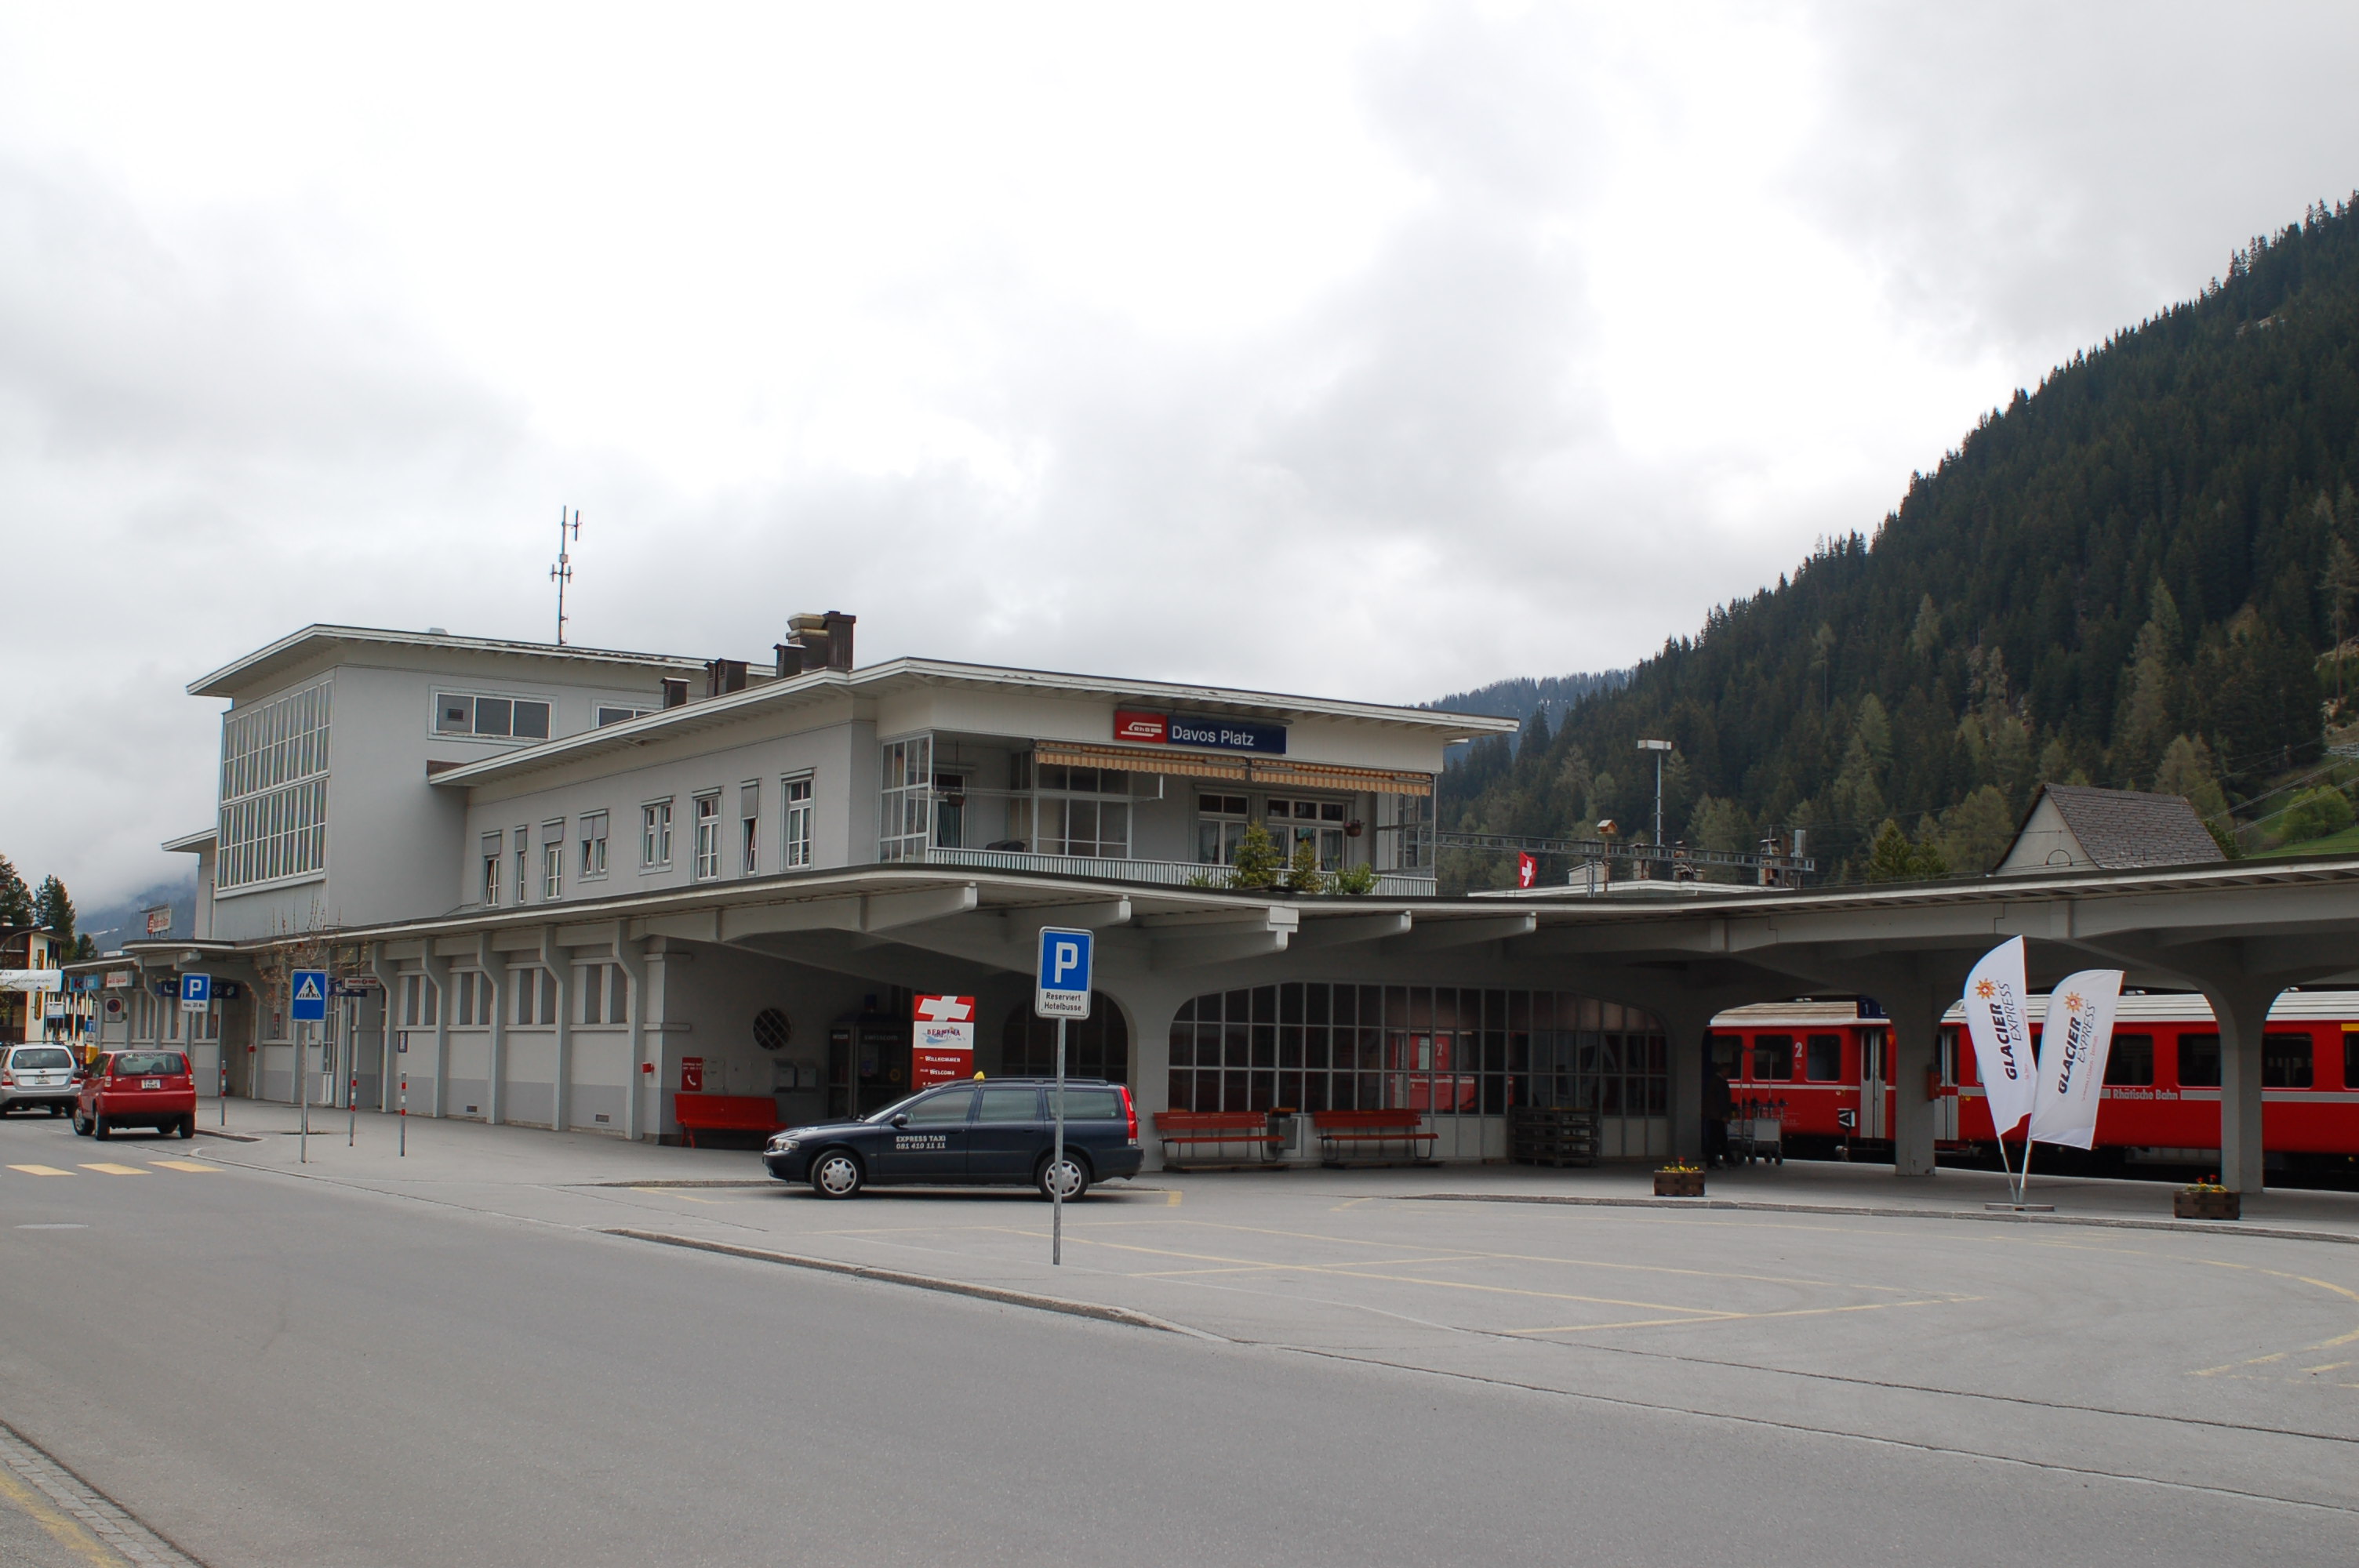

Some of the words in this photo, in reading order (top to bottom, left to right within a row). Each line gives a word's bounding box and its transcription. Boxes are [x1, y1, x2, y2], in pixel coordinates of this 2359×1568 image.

[1172, 725, 1216, 743] Davos
[1220, 730, 1254, 746] Platz
[1054, 942, 1078, 983] P
[189, 979, 202, 997] P
[1045, 992, 1081, 1002] Reserviert
[1044, 1001, 1082, 1011] Hotelbusse
[1999, 983, 2023, 1042] EXPRESS
[1989, 1003, 2019, 1080] GLACIER
[2077, 1004, 2095, 1064] EXPRESS
[1437, 1043, 1443, 1056] 2
[1795, 1042, 1803, 1058] 2
[2057, 1016, 2081, 1094] GLACIER
[2113, 1088, 2154, 1100] Rhätische
[2155, 1088, 2179, 1100] Bahn
